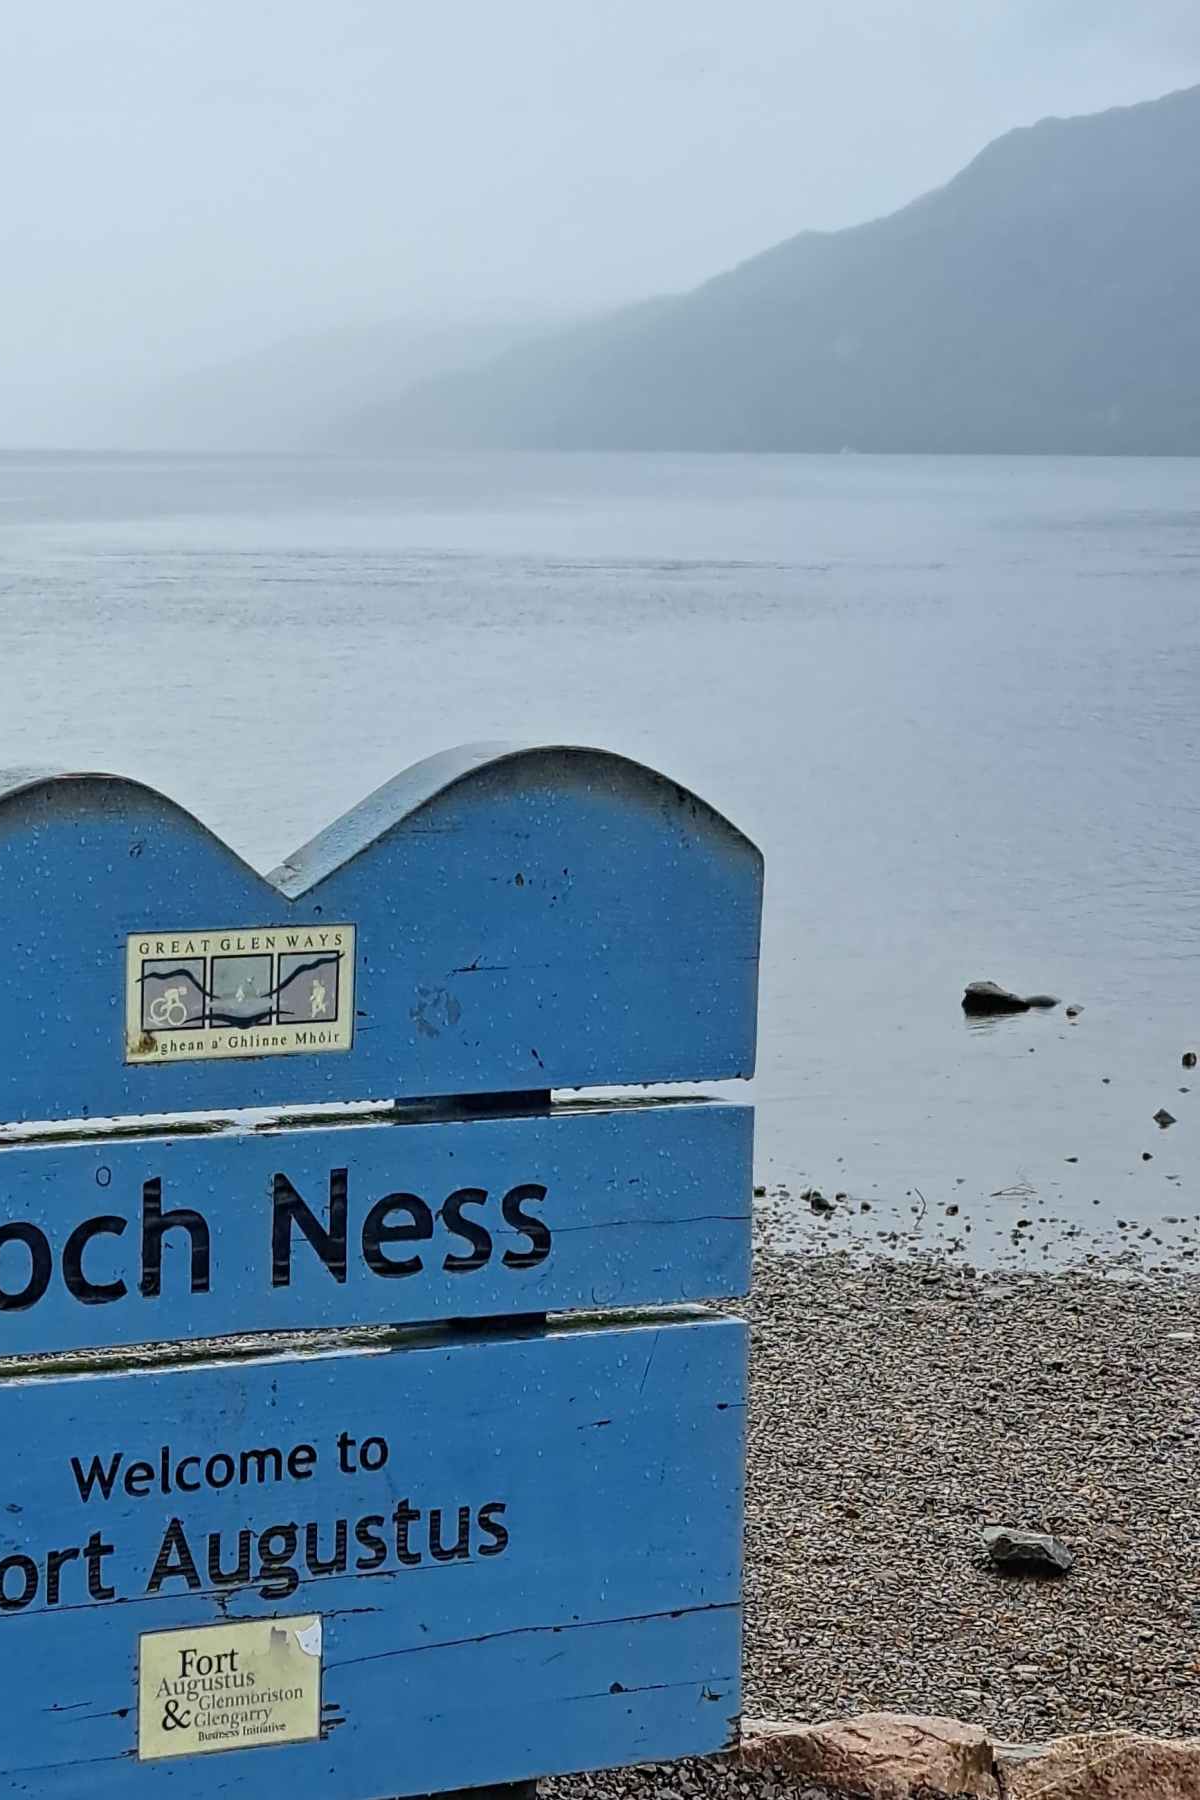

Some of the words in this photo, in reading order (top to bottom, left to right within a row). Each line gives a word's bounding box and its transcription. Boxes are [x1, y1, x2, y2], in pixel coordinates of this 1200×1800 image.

[138, 939, 211, 955] GREAT
[220, 936, 277, 951] GLEN
[286, 933, 344, 948] WAYS
[228, 1035, 288, 1049] Ghlinne
[271, 1168, 552, 1288] Ness
[70, 1444, 318, 1504] Welcome
[337, 1431, 389, 1474] to
[145, 1498, 511, 1601] Augustus
[179, 1648, 239, 1679] Fort
[155, 1671, 256, 1702] Augustus
[199, 1687, 303, 1711] Glenmoriston
[161, 1699, 192, 1731] &
[193, 1707, 273, 1729] Glengarry
[242, 1722, 286, 1736] Initiative
